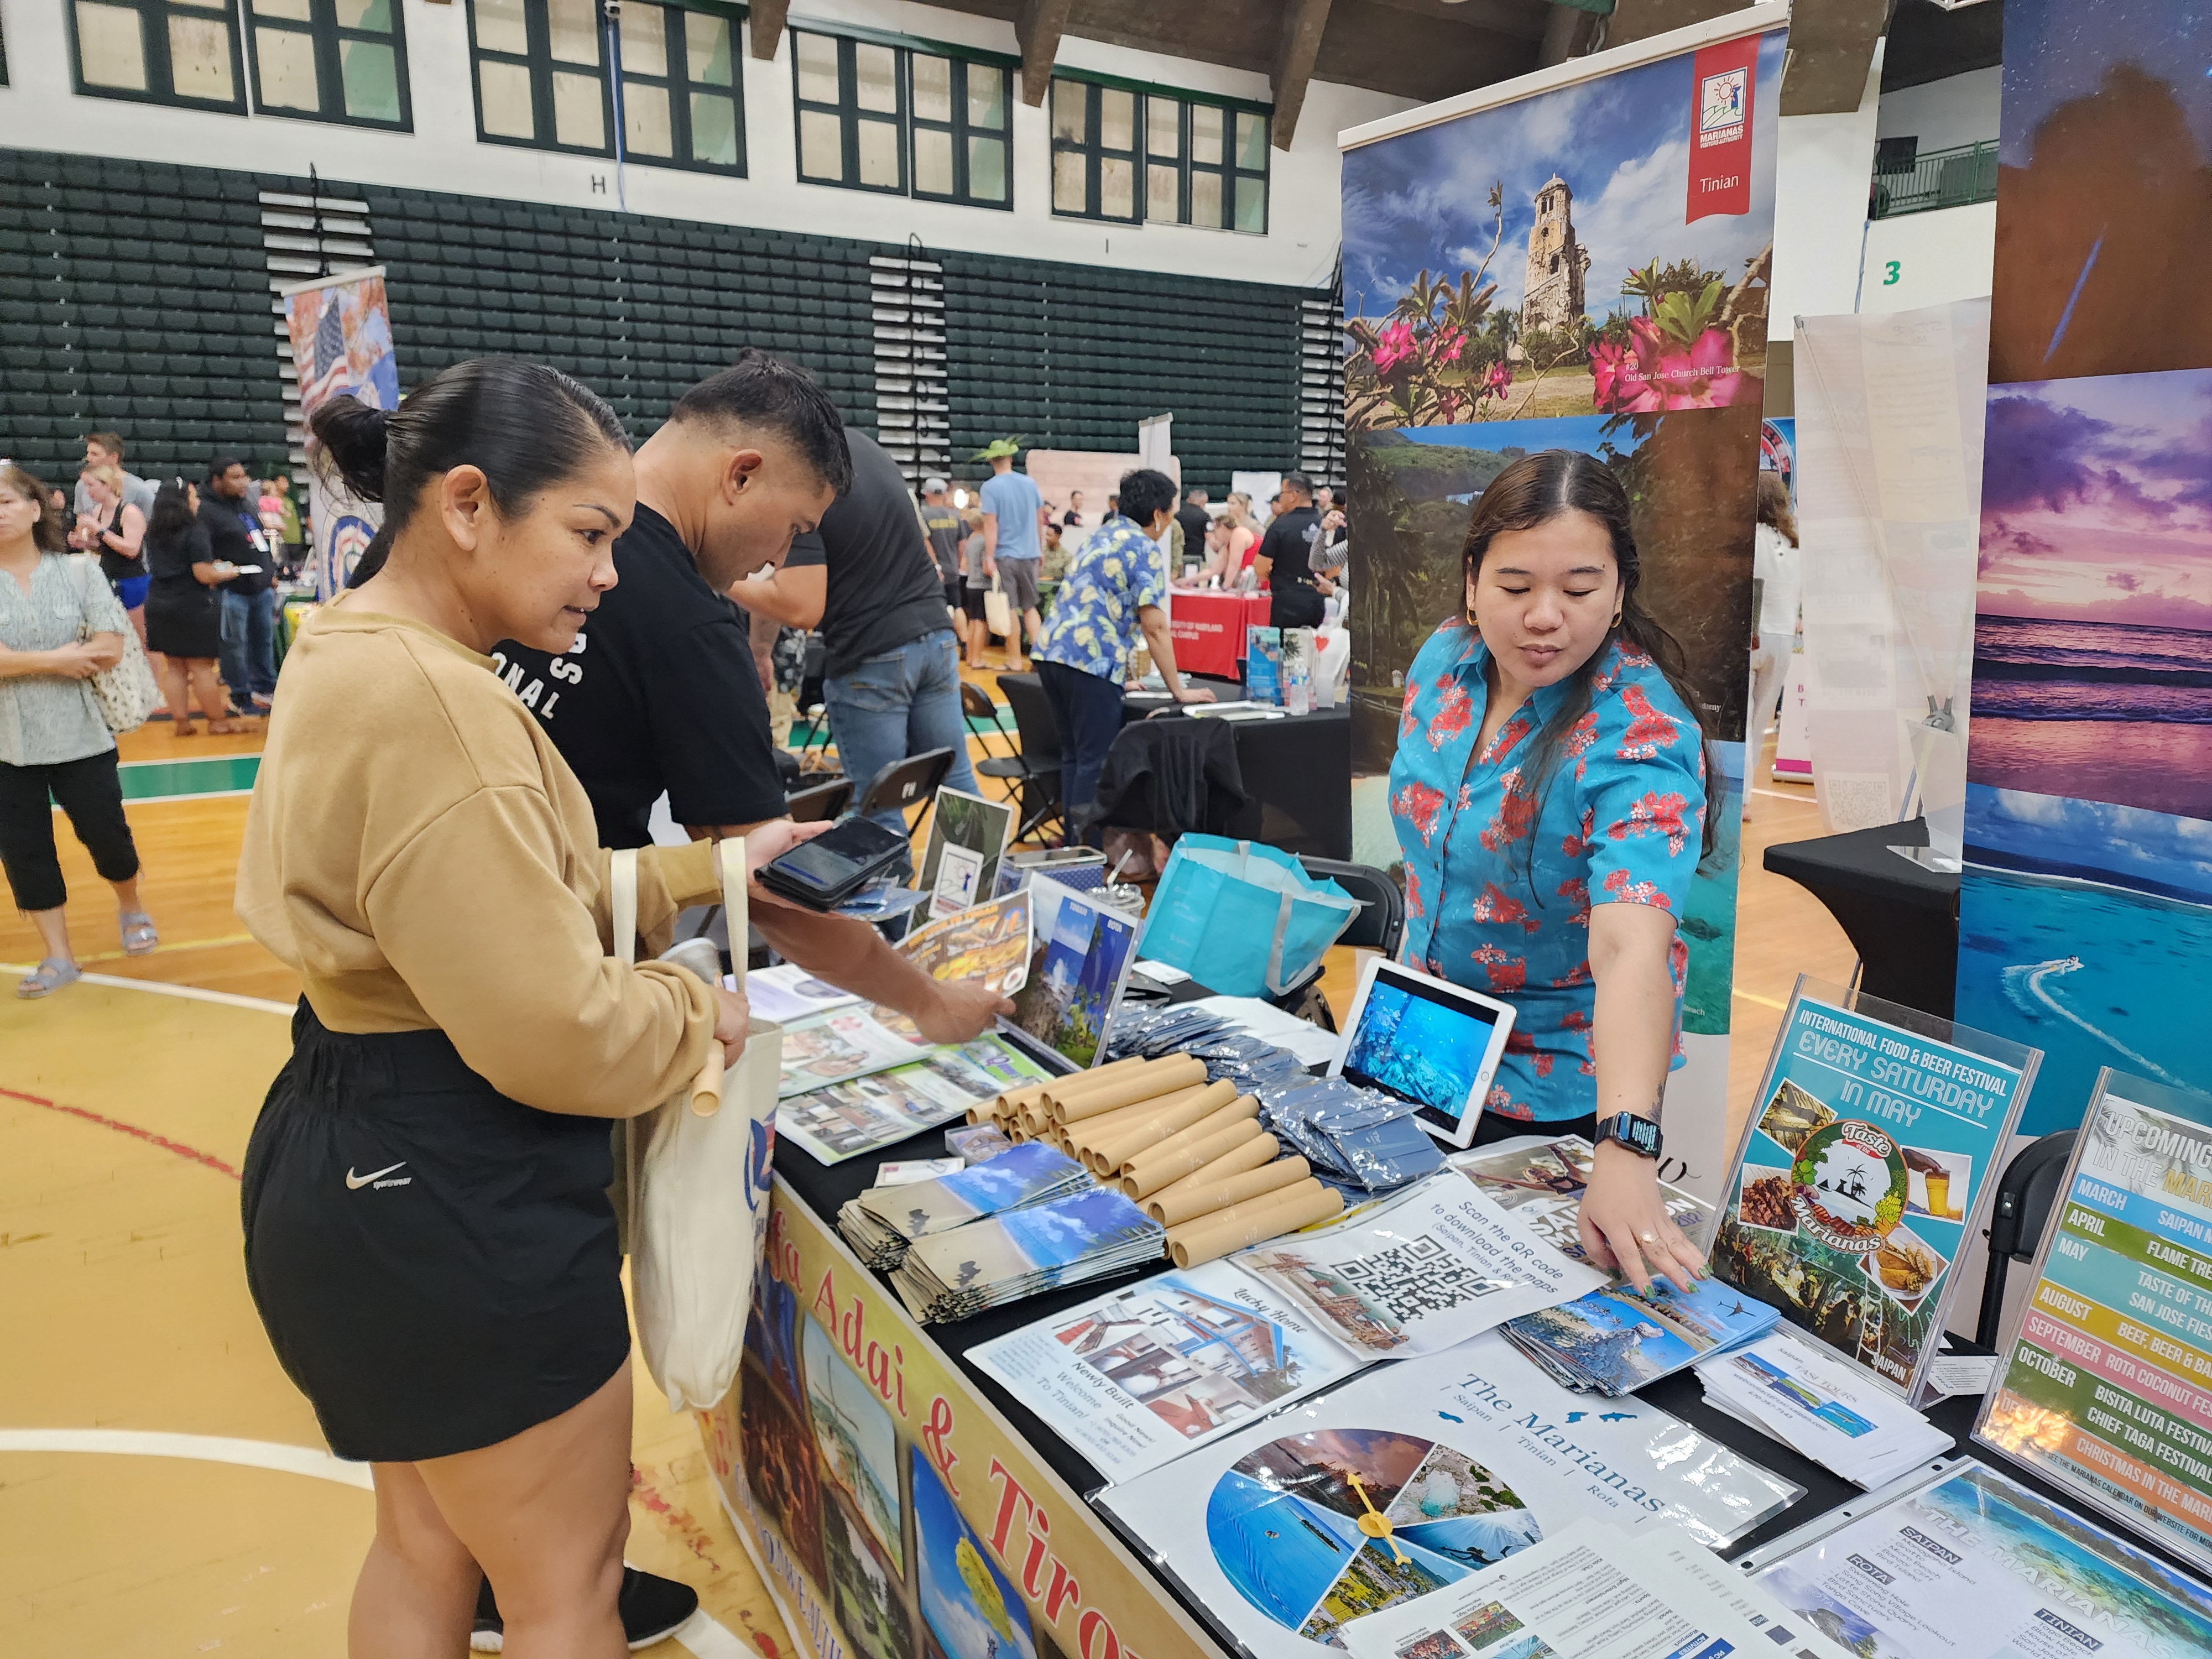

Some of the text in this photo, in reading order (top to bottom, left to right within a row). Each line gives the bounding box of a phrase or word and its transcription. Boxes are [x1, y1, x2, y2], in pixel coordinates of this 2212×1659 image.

[1700, 125, 1744, 143] MARIANAS
[1700, 134, 1743, 148] VISITORS AUTHORITY
[592, 175, 606, 193] H
[1700, 174, 1739, 193] Tinian
[1883, 261, 1900, 285] 3
[1625, 364, 1740, 382] Old San Jose Church Bell Tower
[1626, 362, 1639, 371] #20
[1799, 1009, 2007, 1097] INTERNATIONAL FOOD & BEER FESTIVAL
[1798, 1030, 1994, 1118] EVERY SATURDAY
[1840, 1080, 1922, 1128] IN MAY
[1844, 1123, 1890, 1156] Taste
[1861, 1146, 1870, 1155] the
[2104, 1110, 2212, 1170] UPCOMING
[2093, 1143, 2119, 1172] IN
[2122, 1151, 2163, 1188] THE
[1791, 1196, 1881, 1252] Marianas
[2078, 1178, 2128, 1211] MARCH
[2157, 1210, 2204, 1240] SAIPAN
[1430, 1203, 1559, 1294] to download the maps
[1432, 1222, 1464, 1249] (Saipan,
[1467, 1247, 1493, 1270] Tinian
[1459, 1201, 1563, 1280] Scan the QR code
[2067, 1209, 2106, 1238] APRIL
[2146, 1240, 2190, 1270] FLAME
[2058, 1238, 2194, 1305] MAY TASTE OF
[1233, 1287, 1307, 1334] Lucky Home
[2038, 1286, 2193, 1368] AUGUST BEEF, BEER &
[2128, 1292, 2157, 1314] SAN
[2154, 1303, 2187, 1326] JOSE
[1777, 1347, 1804, 1364] Saipan
[1871, 1351, 1907, 1382] SAIPAN
[2028, 1316, 2102, 1364] SEPTEMBER
[2105, 1353, 2137, 1380] ROTA
[2136, 1368, 2194, 1406] COCONUT
[1036, 1377, 1090, 1420] To Tinian!
[1057, 1371, 1102, 1409] Welcome
[1071, 1361, 1134, 1410] Newly Built
[1822, 1380, 1859, 1404] TOURS
[2018, 1346, 2077, 1389] OCTOBER
[2094, 1384, 2133, 1417] BISITA
[2133, 1405, 2166, 1433] LUTA
[769, 1211, 802, 1293] fa
[815, 1269, 908, 1418] Adai
[922, 1396, 960, 1497] &
[987, 1455, 1144, 1659] Tiro
[1104, 1417, 1128, 1438] Inquire
[1115, 1412, 1134, 1428] Good
[1453, 1393, 1620, 1509] Saipan Tinian Rota
[1456, 1373, 1667, 1512] The Marianas
[2087, 1406, 2212, 1485] CHIEF TAGA FESTIVAL
[2075, 1437, 2182, 1505] CHRISTMAS IN THE
[2047, 1453, 2199, 1542] SEE THE MARIANAS CALENDAR ON OUR WEBSITE FOR
[1887, 1545, 1942, 1579] Micro Beach
[1895, 1541, 1926, 1562] Grotto
[1902, 1527, 1960, 1564] SAIPAN
[1581, 1557, 1604, 1572] Kids Club
[1849, 1556, 1889, 1583] ROTA
[1875, 1552, 1922, 1583] Bird Island
[1881, 1548, 1935, 1583] Banzai Cliff
[1947, 1565, 1977, 1585] Island
[1584, 1577, 1630, 1605] Night Entertainment
[1804, 1586, 1835, 1609] ROTA
[1821, 1580, 1871, 1616] Tonga Cave
[1827, 1577, 1893, 1622] Bird Sanctuary
[1848, 1565, 1910, 1608] Swimming Hole
[1924, 1508, 2177, 1659] THE MARIANAS
[1834, 1573, 1920, 1632] Latte Stone Quarry
[1841, 1569, 1957, 1647] Song Song Village Lookout
[1678, 1635, 1707, 1656] ACTIVITIES
[2017, 1634, 2037, 1649] San
[2024, 1629, 2067, 1657] House of
[2030, 1625, 2078, 1657] Blow Hole
[2038, 1609, 2099, 1650] TINIAN
[2038, 1621, 2095, 1658] Taga Beach
[2012, 1638, 2042, 1659] World
